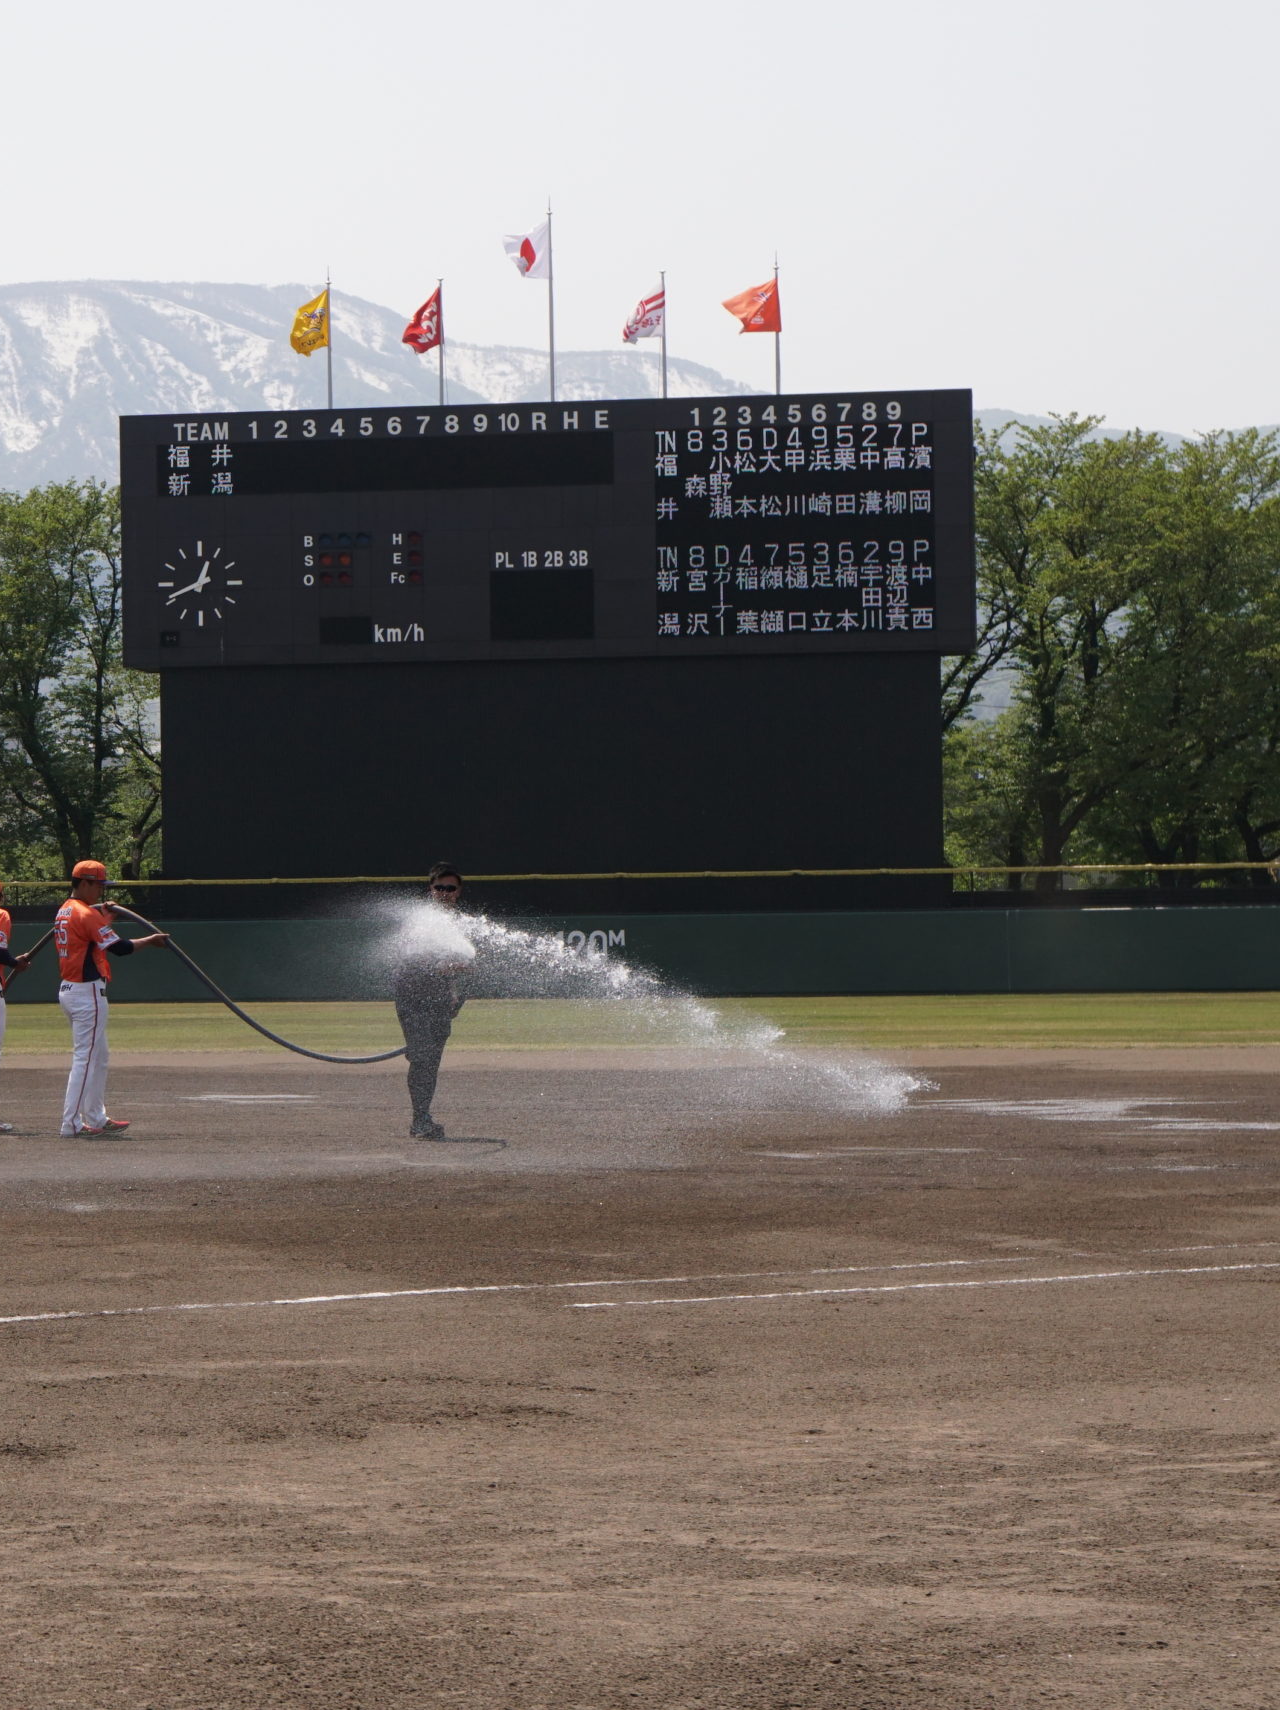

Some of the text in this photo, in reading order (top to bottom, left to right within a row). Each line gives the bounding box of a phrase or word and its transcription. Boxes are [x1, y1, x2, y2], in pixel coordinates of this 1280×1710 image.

[173, 410, 608, 441] TEAM 1 2 3 4 5 6 7 8 9 10 R H E
[690, 402, 901, 426] 1 2 3 4 5 6 7 8 9
[655, 423, 927, 453] TN 8 3 6 D 4 9 5 2 7 P
[168, 444, 232, 467] 福井
[168, 472, 233, 496] 新潟
[655, 452, 678, 520] 福井
[686, 475, 707, 497] 森
[710, 452, 732, 518] 小野瀬
[734, 452, 757, 517] 松本
[760, 450, 781, 517] 大松
[834, 448, 856, 514] 栗田
[883, 445, 906, 513] 高柳
[304, 536, 313, 547] B
[393, 533, 402, 545] H
[658, 540, 928, 568] TN 8 D 4 7 5 3 6 2 9 P
[305, 555, 313, 566] S
[393, 553, 402, 564] E
[496, 550, 588, 568] PL 1B 2B 3B
[304, 575, 314, 586] O
[391, 572, 405, 583] Fc
[657, 569, 680, 635] 新潟
[687, 569, 709, 634] 宮沢
[736, 567, 758, 633] 稲葉
[811, 565, 833, 631] 足立
[835, 564, 858, 631] 楠本
[860, 565, 883, 629] 宇田川
[911, 564, 933, 629] 中西
[375, 623, 424, 642] km/h
